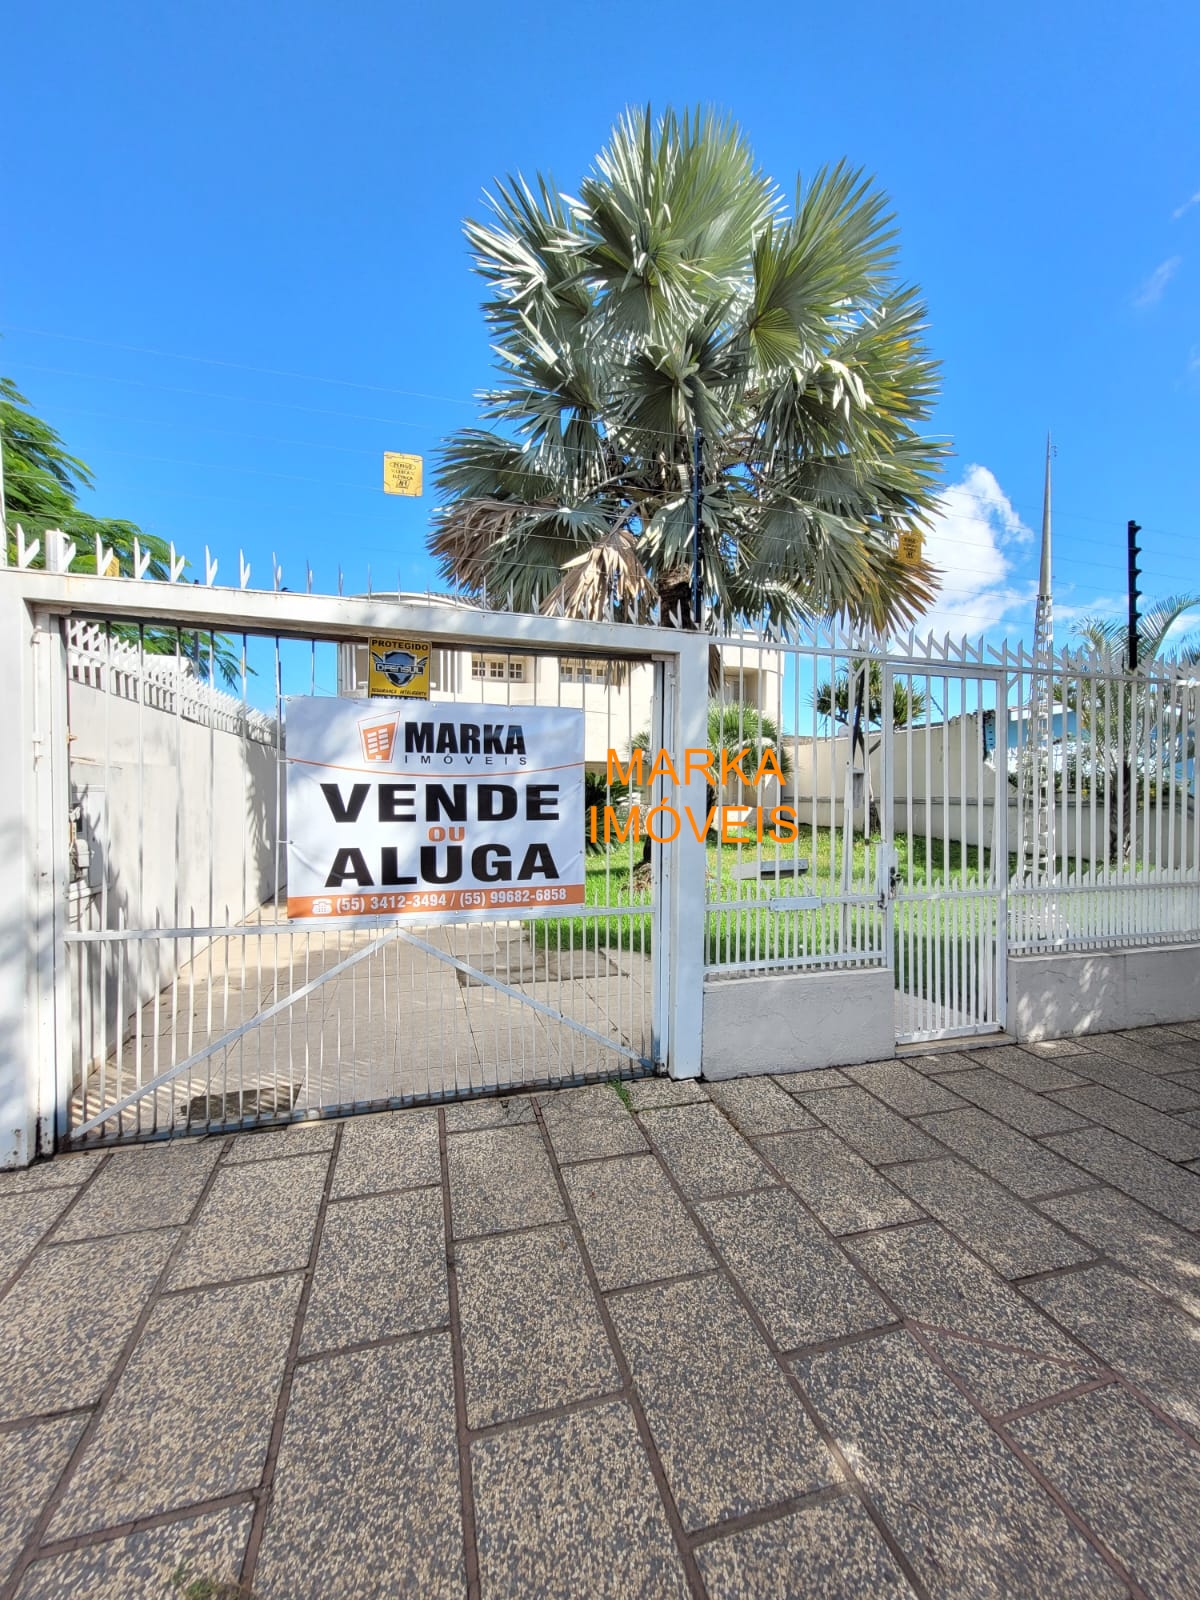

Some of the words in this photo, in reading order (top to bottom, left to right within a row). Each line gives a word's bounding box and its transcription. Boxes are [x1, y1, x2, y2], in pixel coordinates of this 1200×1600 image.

[371, 639, 429, 651] PROTEGIDO
[404, 721, 527, 755] MARKA
[404, 753, 527, 766] IMÓVEIS
[320, 783, 560, 823] VENDE
[428, 826, 465, 842] OU
[324, 843, 560, 888] ALUGA
[336, 896, 366, 913] (55)
[370, 893, 447, 910] 3412-3494
[459, 891, 486, 907] (55)
[490, 888, 567, 904] 99682-6858
